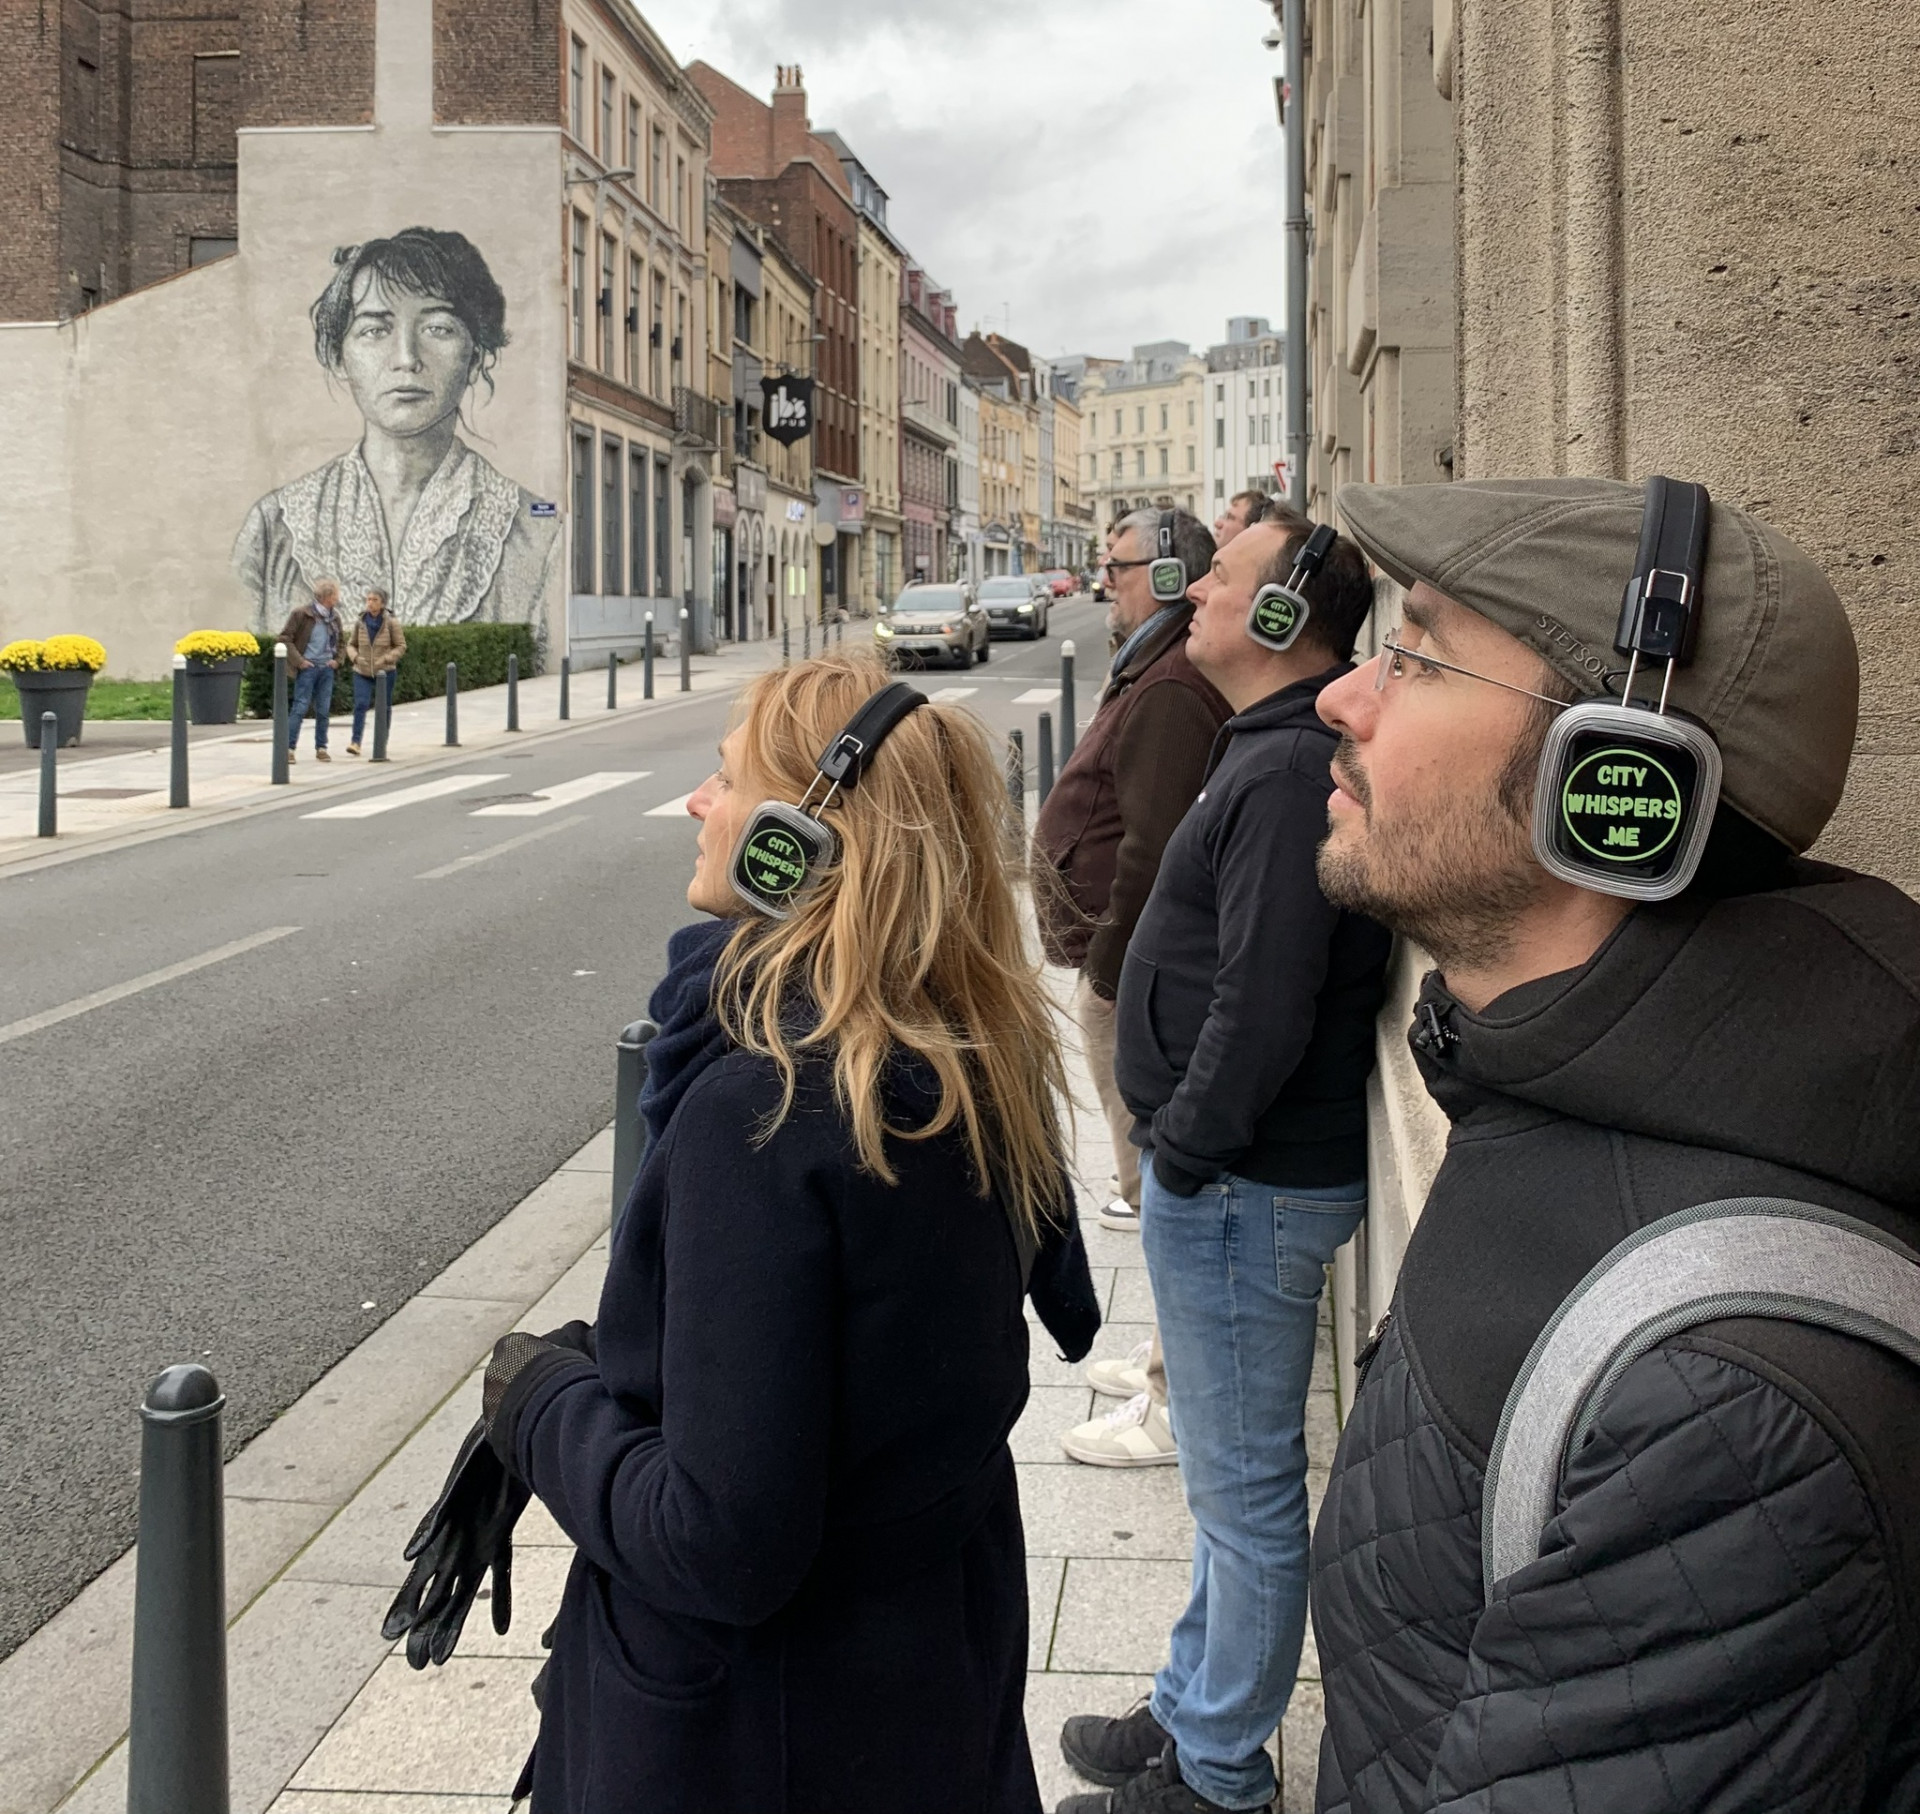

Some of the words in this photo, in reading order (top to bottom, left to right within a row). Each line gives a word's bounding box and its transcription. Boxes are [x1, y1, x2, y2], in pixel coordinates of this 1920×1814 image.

[1597, 765, 1648, 787] CITY
[1568, 793, 1678, 819] WHISPERS
[767, 836, 795, 856] CITY
[1602, 826, 1641, 847] .ME
[748, 845, 804, 879] WHISPERS
[759, 870, 780, 887] .ME
